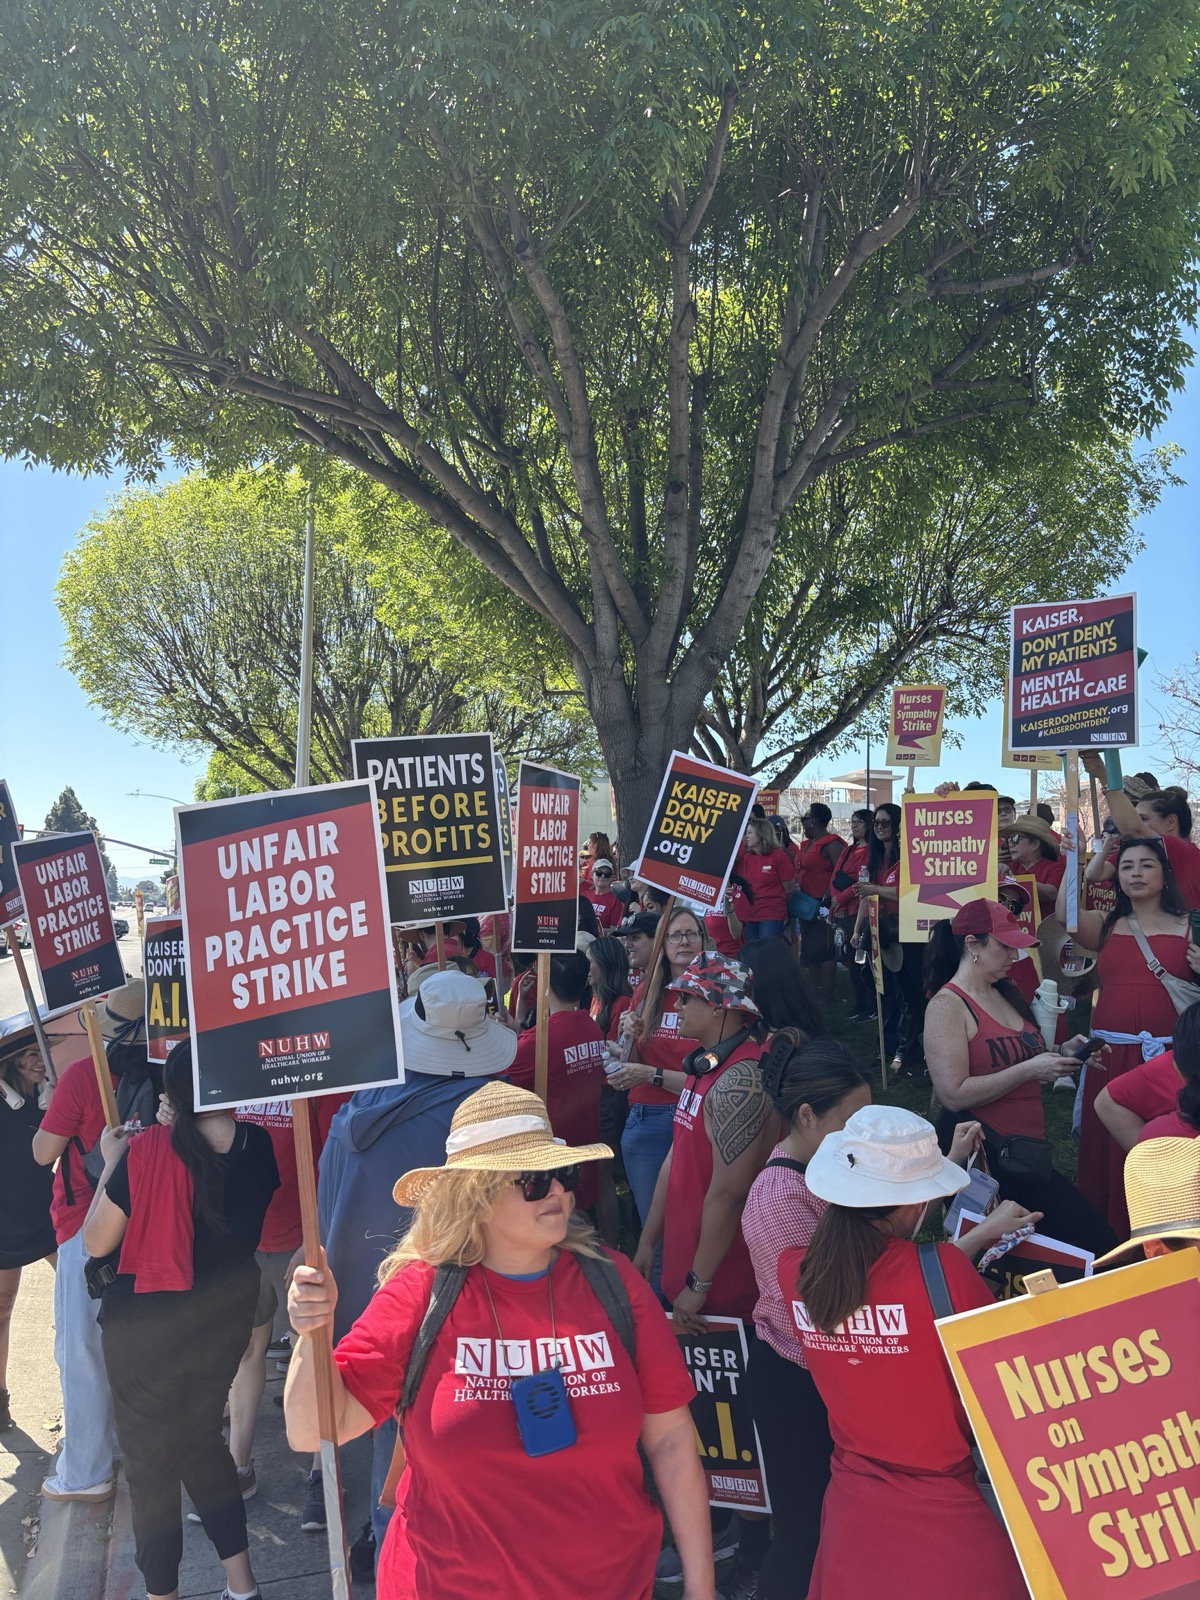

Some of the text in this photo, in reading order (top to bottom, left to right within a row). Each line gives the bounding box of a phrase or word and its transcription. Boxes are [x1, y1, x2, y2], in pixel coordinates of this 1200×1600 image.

[1022, 608, 1083, 634] KAISER,
[1022, 619, 1115, 656] DON'T DENY
[1021, 636, 1117, 673] MY PATIENTS
[1020, 668, 1084, 695] MENTAL
[1020, 674, 1127, 711] HEALTH CARE
[899, 694, 932, 704] Nurses
[896, 709, 938, 720] Sympathy
[902, 720, 932, 731] Strike
[1020, 704, 1128, 733] KAISERDONTDENY.org
[1038, 717, 1110, 737] #KAISERDONTDENY
[1090, 732, 1127, 742] NUHW
[366, 752, 485, 791] PATIENTS
[532, 792, 570, 815] UNFAIR
[671, 781, 742, 812] KAISER
[665, 798, 723, 827] DONT
[914, 808, 974, 827] Nurses
[533, 819, 567, 841] LABOR
[659, 817, 714, 844] DENY
[923, 829, 935, 837] on
[217, 820, 340, 880] UNFAIR
[522, 845, 574, 868] PRACTICE
[653, 839, 693, 865] .org
[911, 835, 987, 856] Sympathy
[35, 852, 88, 885] UNFAIR
[924, 856, 978, 877] Strike
[44, 876, 90, 909] LABOR
[227, 864, 337, 923] LABOR
[410, 877, 464, 894] NUHW
[530, 871, 566, 895] STRIKE
[679, 875, 716, 897] NUHW
[37, 894, 105, 938] PRACTICE
[424, 905, 454, 913] nuhw.org
[537, 915, 559, 926] NUHW
[53, 920, 101, 956] STRIKE
[147, 940, 184, 957] KAISER
[204, 900, 369, 973] PRACTICE
[71, 964, 100, 980] NUHW
[148, 958, 186, 977] DON'T
[231, 949, 348, 1011] STRIKE
[149, 982, 187, 1027] A.I.
[258, 1032, 330, 1057] NUHW
[261, 1055, 331, 1071] HEALTHCARE WORKERS
[265, 1055, 295, 1064] NATIONAL
[296, 1051, 317, 1060] UNION
[271, 1072, 323, 1086] nuhw.org
[266, 1120, 293, 1128] WORKERS
[794, 1304, 903, 1333] NHW
[802, 1331, 899, 1345] NATIONAL UNION OF
[861, 1344, 910, 1355] WORKERS
[457, 1334, 610, 1374] NUHW
[684, 1345, 738, 1369] ISER
[465, 1371, 607, 1389] NATIO ION OF
[688, 1368, 740, 1395] N'T
[994, 1328, 1172, 1420] Nurses
[567, 1382, 621, 1398] ORKERS
[693, 1401, 752, 1462] .I.
[1047, 1417, 1084, 1449] on
[1026, 1410, 1200, 1515] Sympath
[711, 1475, 759, 1493] NUHW
[1088, 1486, 1200, 1578] Strik
